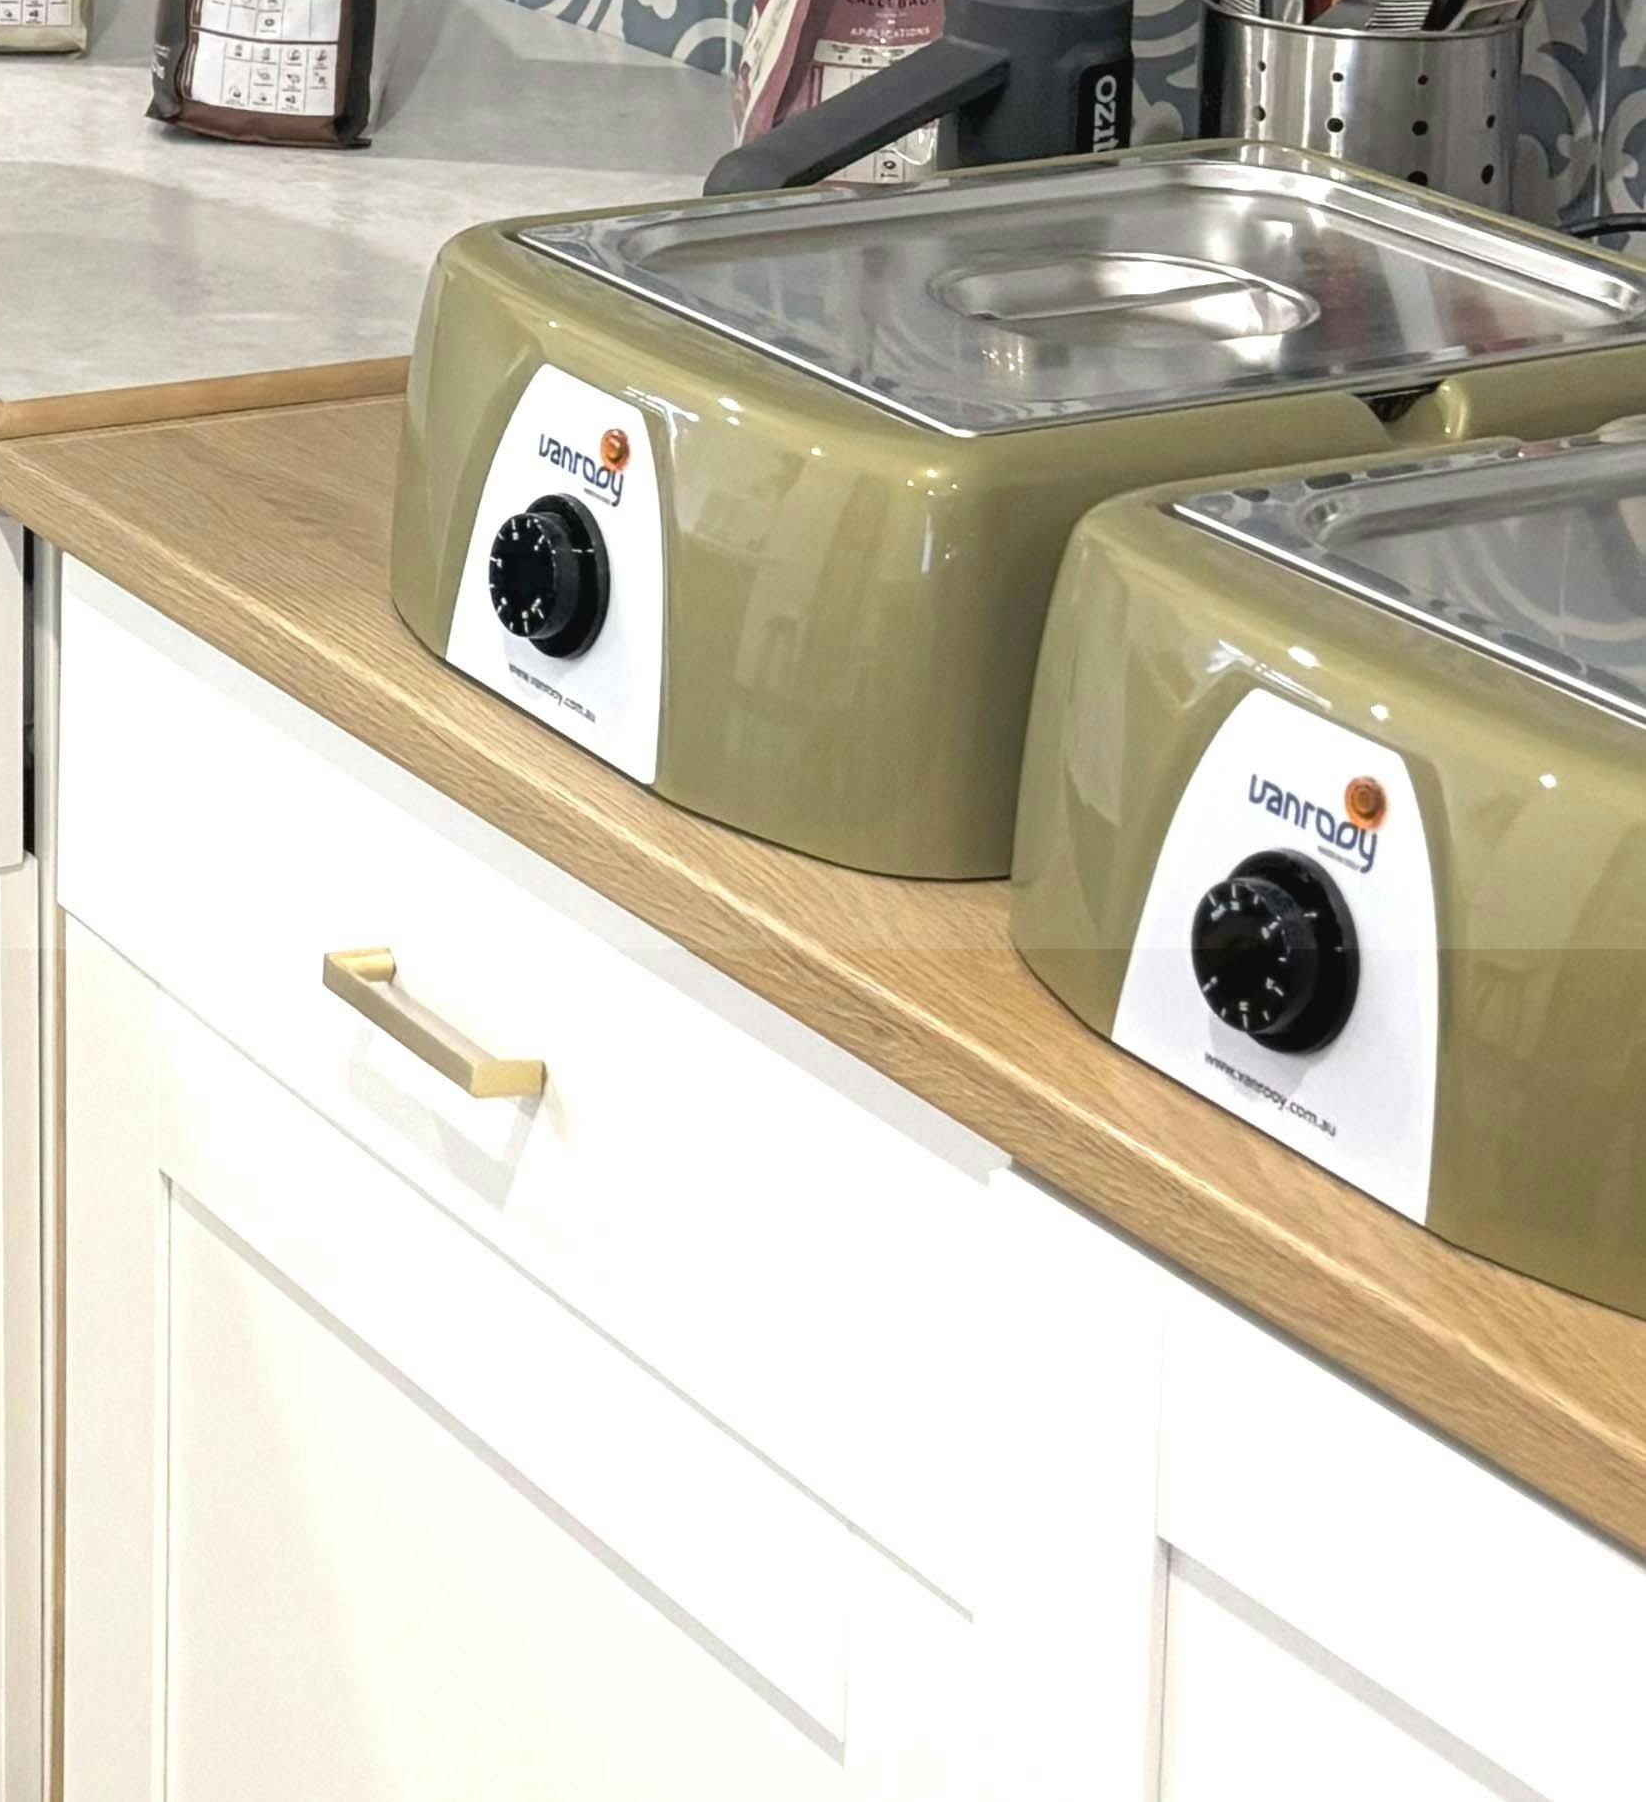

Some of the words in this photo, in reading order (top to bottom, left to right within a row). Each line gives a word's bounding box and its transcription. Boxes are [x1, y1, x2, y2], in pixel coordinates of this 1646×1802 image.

[850, 26, 931, 39] APPLICATIONS
[538, 433, 624, 507] vanrooy
[1248, 773, 1377, 874] vanrooy
[1204, 1051, 1336, 1137] www.vanrooy.com.au
